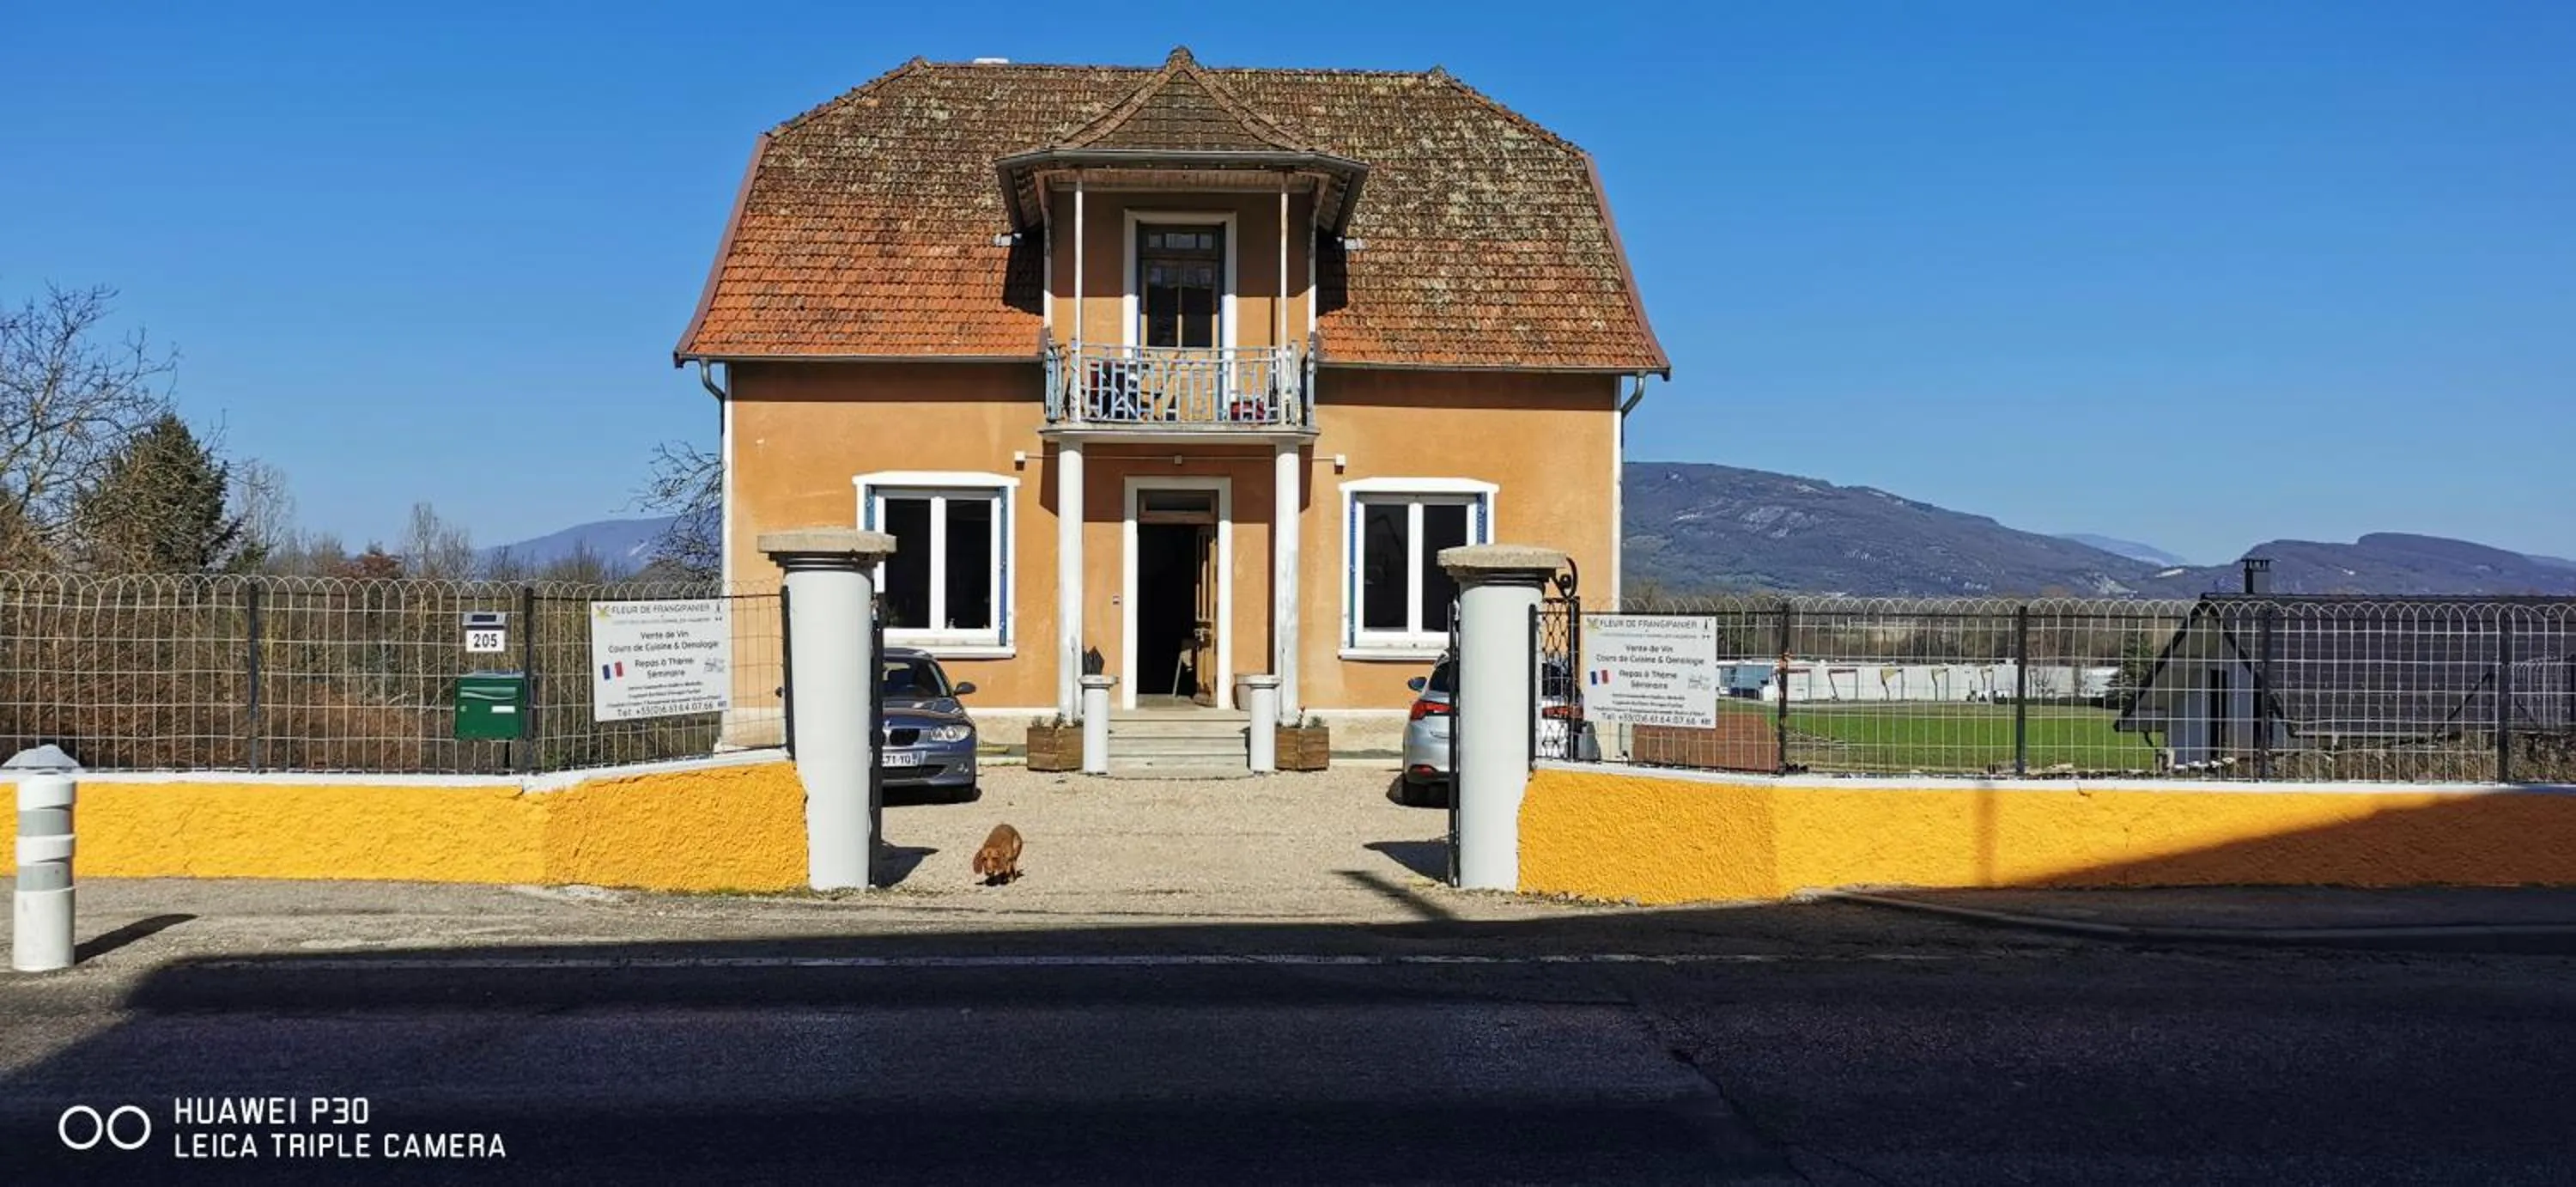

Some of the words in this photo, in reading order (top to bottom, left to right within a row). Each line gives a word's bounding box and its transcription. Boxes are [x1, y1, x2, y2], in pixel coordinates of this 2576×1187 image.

[611, 606, 638, 615] FLEUR
[641, 605, 650, 613] DE
[653, 604, 710, 613] FRANGIPANIER
[1638, 620, 1697, 629] FRANGIPANIER
[641, 631, 663, 640] Vente
[473, 634, 497, 648] 205
[646, 642, 671, 651] Cuisine
